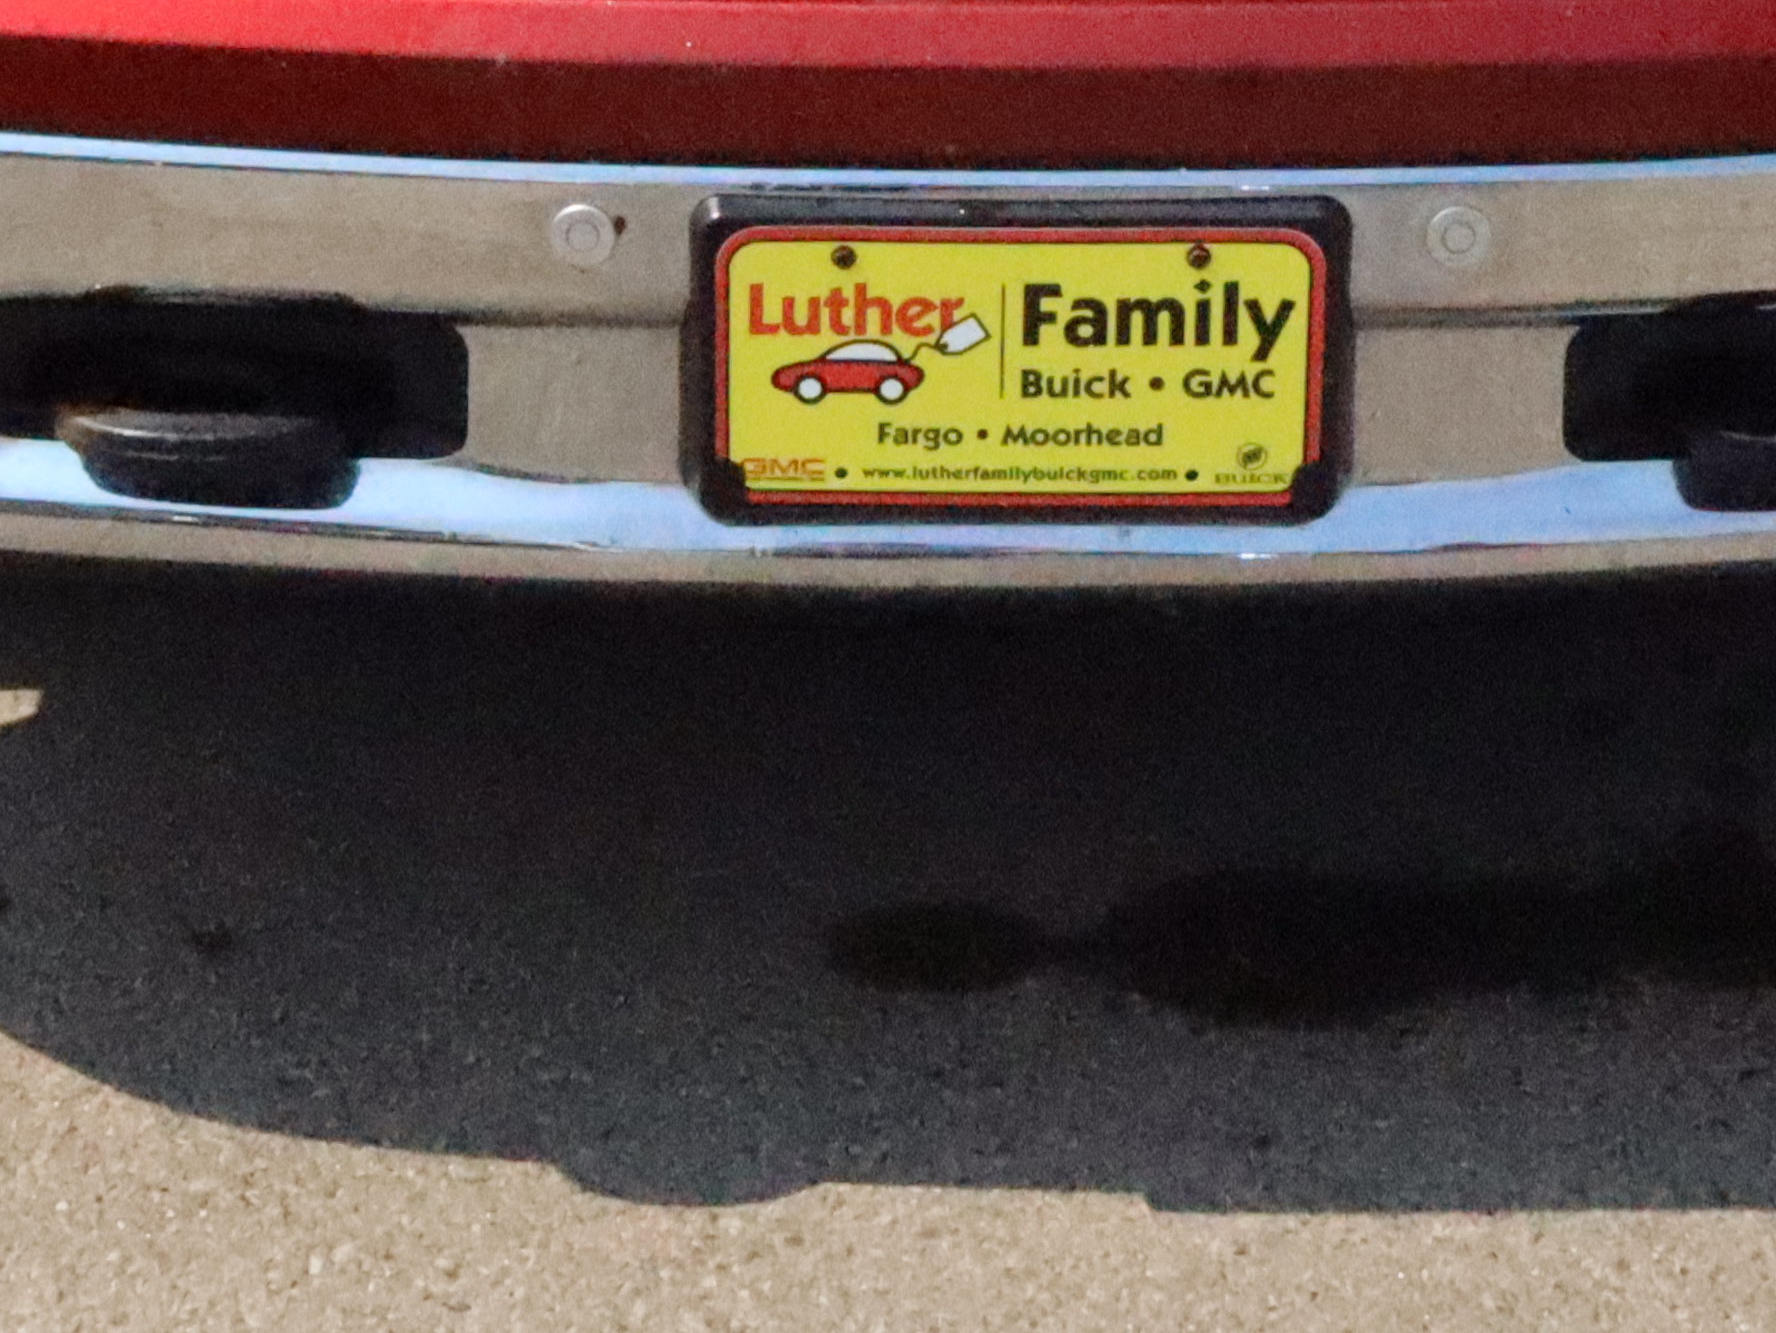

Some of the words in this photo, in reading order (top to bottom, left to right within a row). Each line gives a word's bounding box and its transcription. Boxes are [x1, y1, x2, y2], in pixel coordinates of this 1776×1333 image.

[749, 282, 965, 337] Luther
[1022, 278, 1296, 363] Family
[1020, 368, 1132, 399] Buick
[1182, 368, 1276, 399] GMC
[877, 422, 964, 451] Fargo
[1000, 422, 1164, 447] Moorhead
[742, 457, 826, 476] GMC
[862, 464, 1178, 483] www.lutherfamilybuickgmc.com
